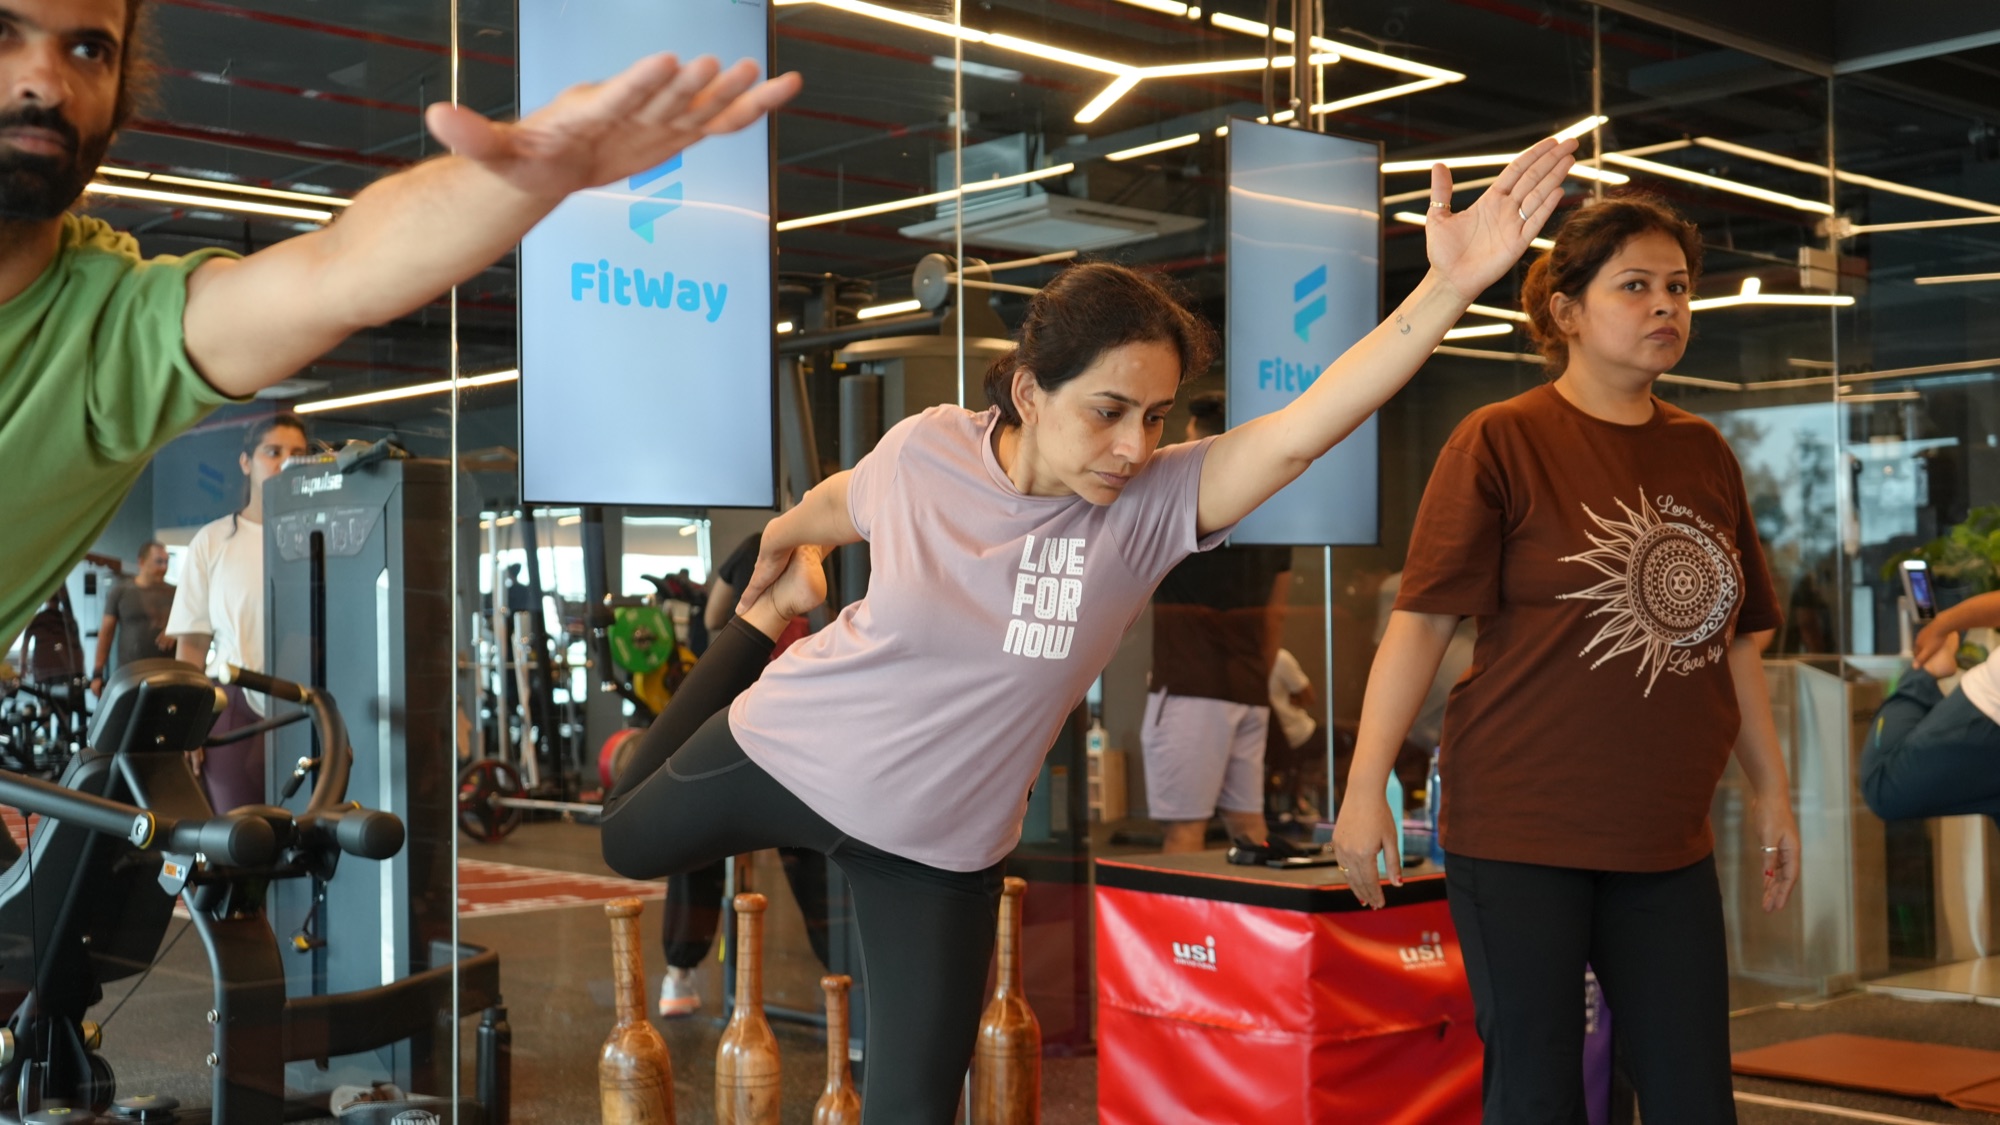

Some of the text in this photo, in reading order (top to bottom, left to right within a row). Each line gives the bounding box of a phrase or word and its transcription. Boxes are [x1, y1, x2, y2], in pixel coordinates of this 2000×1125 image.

[571, 258, 728, 323] FitWay
[1259, 356, 1321, 392] FitW
[1657, 494, 1694, 518] Love
[1018, 534, 1086, 576] LIVE
[1012, 572, 1083, 622] FOR
[1002, 618, 1075, 660] NOW
[1667, 649, 1706, 676] Love
[1172, 935, 1217, 964] usi
